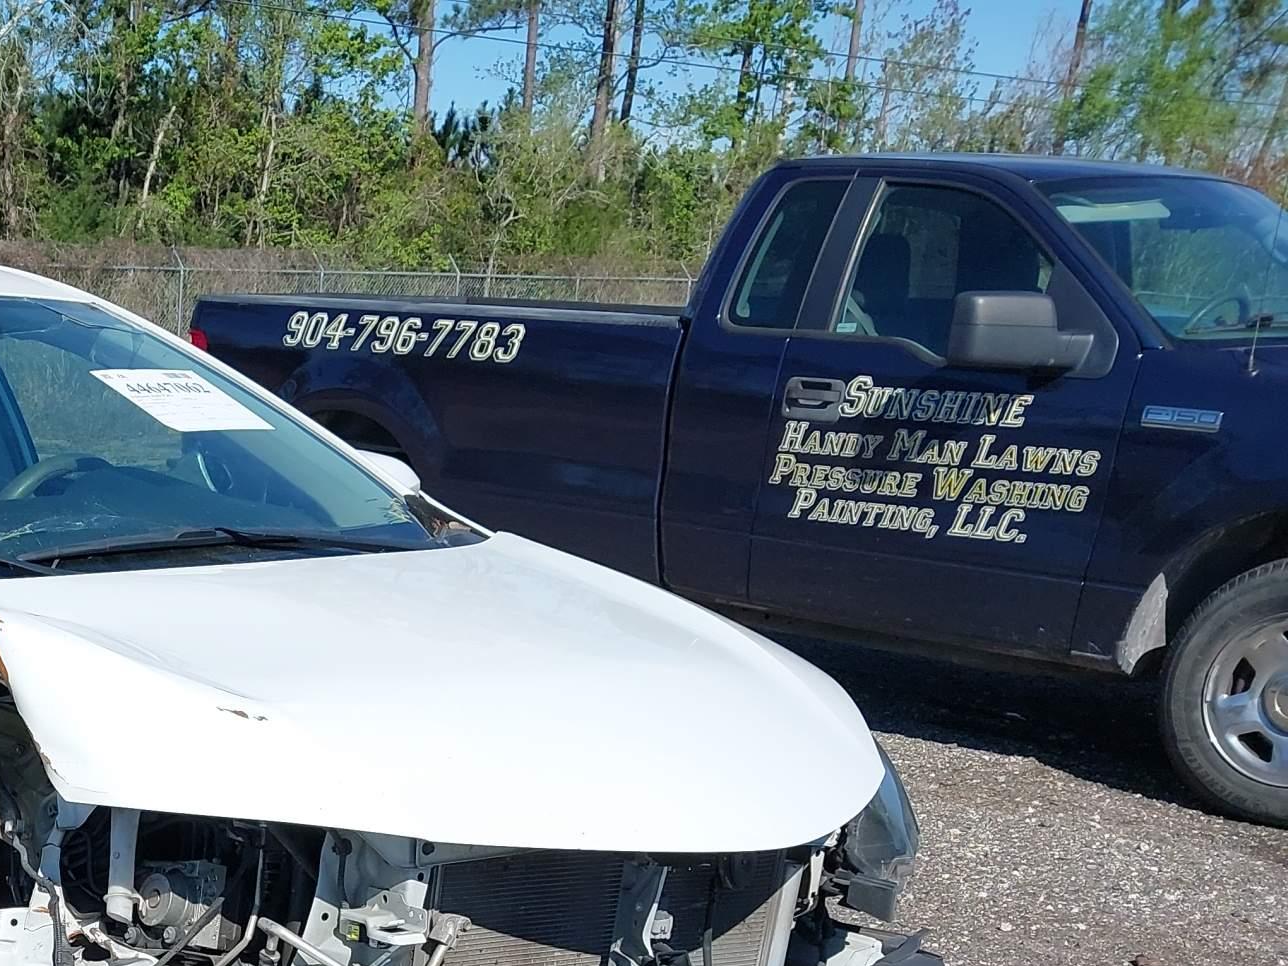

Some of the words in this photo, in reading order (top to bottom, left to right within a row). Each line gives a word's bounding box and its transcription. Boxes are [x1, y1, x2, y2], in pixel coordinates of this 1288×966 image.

[283, 311, 526, 363] 904-796-7783
[838, 375, 1034, 427] SUNSHINE
[779, 421, 883, 458] HANDY
[887, 428, 968, 466] MAN
[971, 434, 1101, 476] LAWNS
[769, 453, 922, 498] PRESSURE
[932, 467, 1090, 512] WASHING
[788, 487, 937, 538] PAINTING,
[946, 504, 1028, 543] LLC.
